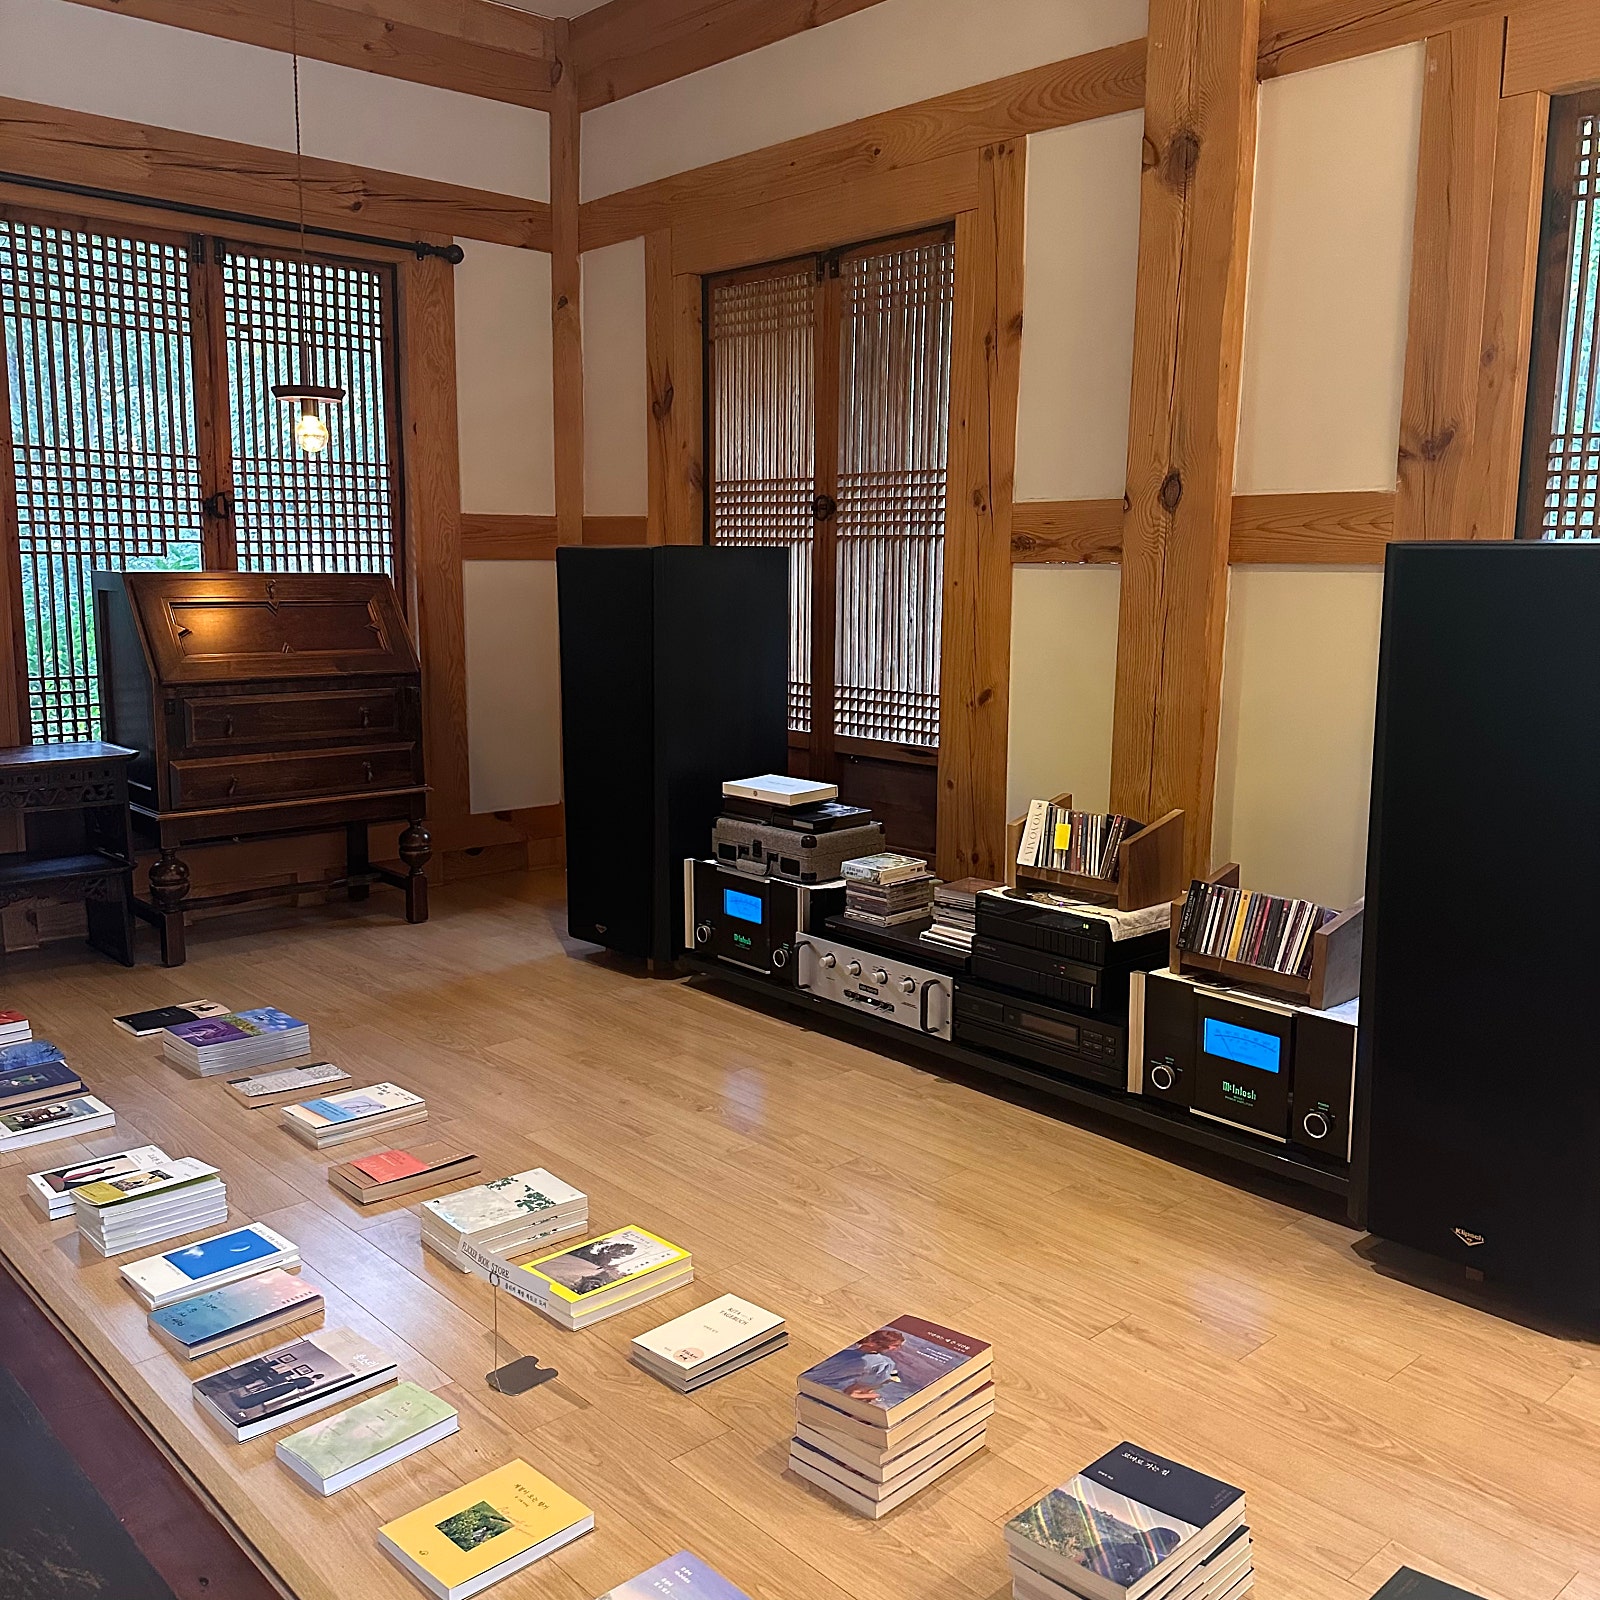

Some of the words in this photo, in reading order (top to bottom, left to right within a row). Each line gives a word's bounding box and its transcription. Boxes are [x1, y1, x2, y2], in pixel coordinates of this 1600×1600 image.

[1222, 1080, 1257, 1101] McIntosh
[1455, 1227, 1483, 1241] Klipsch
[462, 1241, 478, 1260] FLICKER
[477, 1254, 490, 1270] BOOK
[491, 1263, 510, 1279] STORE
